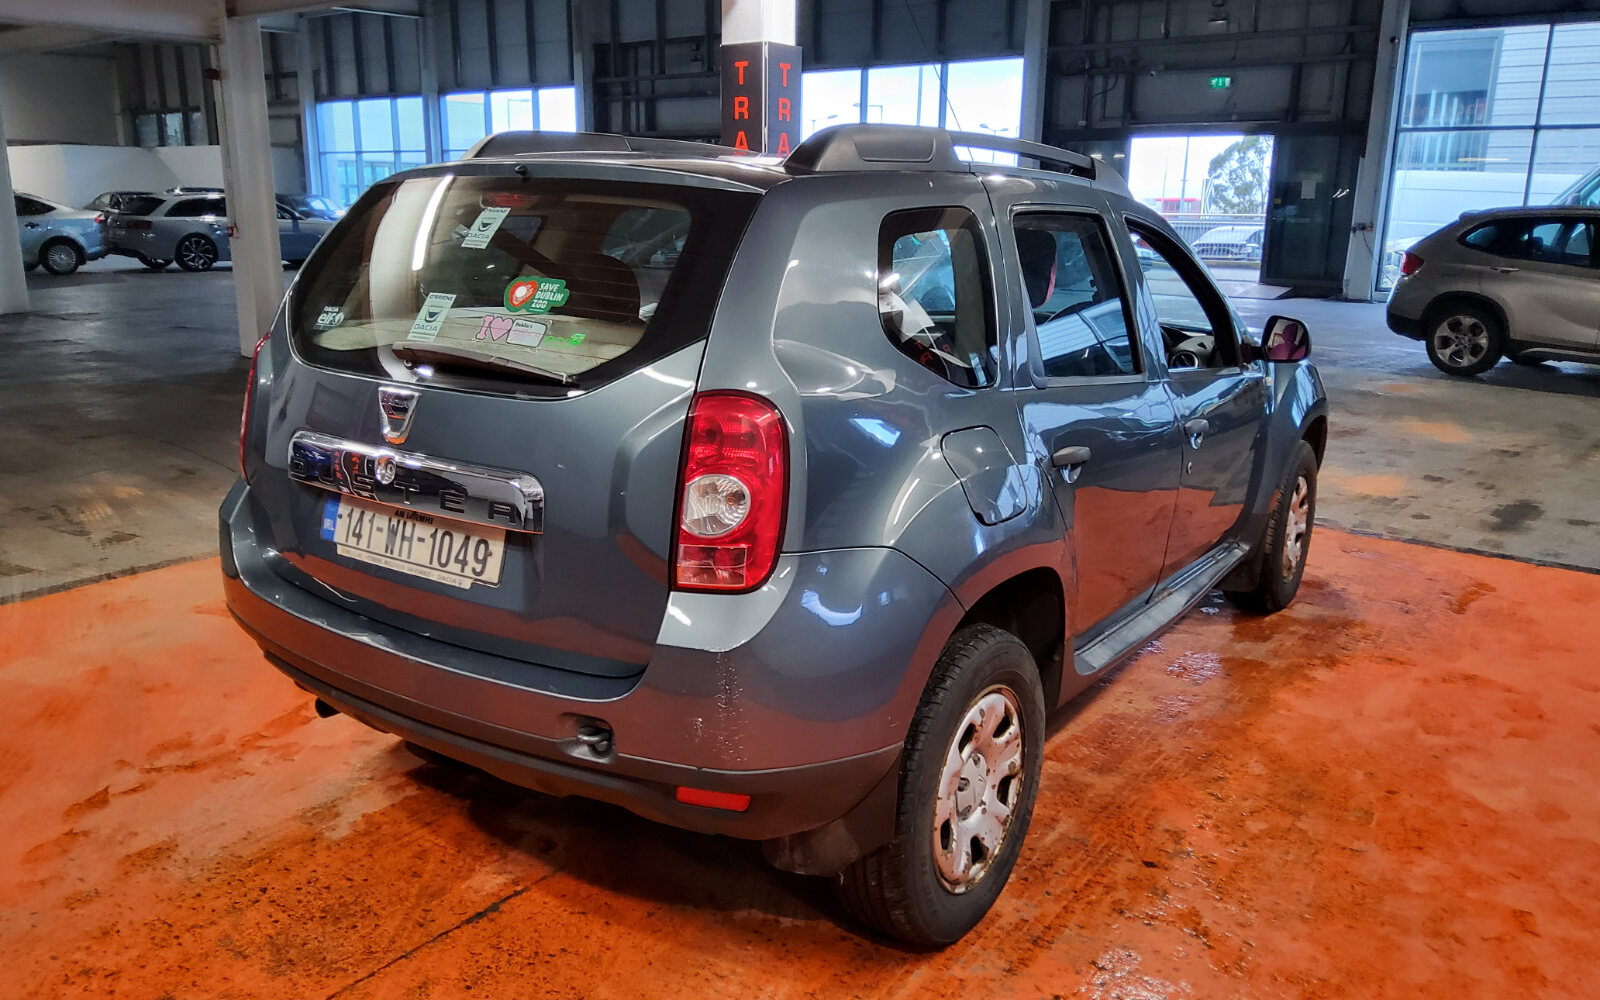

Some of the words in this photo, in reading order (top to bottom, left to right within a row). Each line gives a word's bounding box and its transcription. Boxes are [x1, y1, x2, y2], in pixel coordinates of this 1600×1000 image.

[539, 282, 560, 292] SAVE
[534, 291, 564, 302] DUBLIN
[531, 299, 548, 309] ZOO
[413, 323, 438, 332] DACIA
[323, 518, 335, 531] IRL
[345, 507, 491, 577] 141-WH-1049
